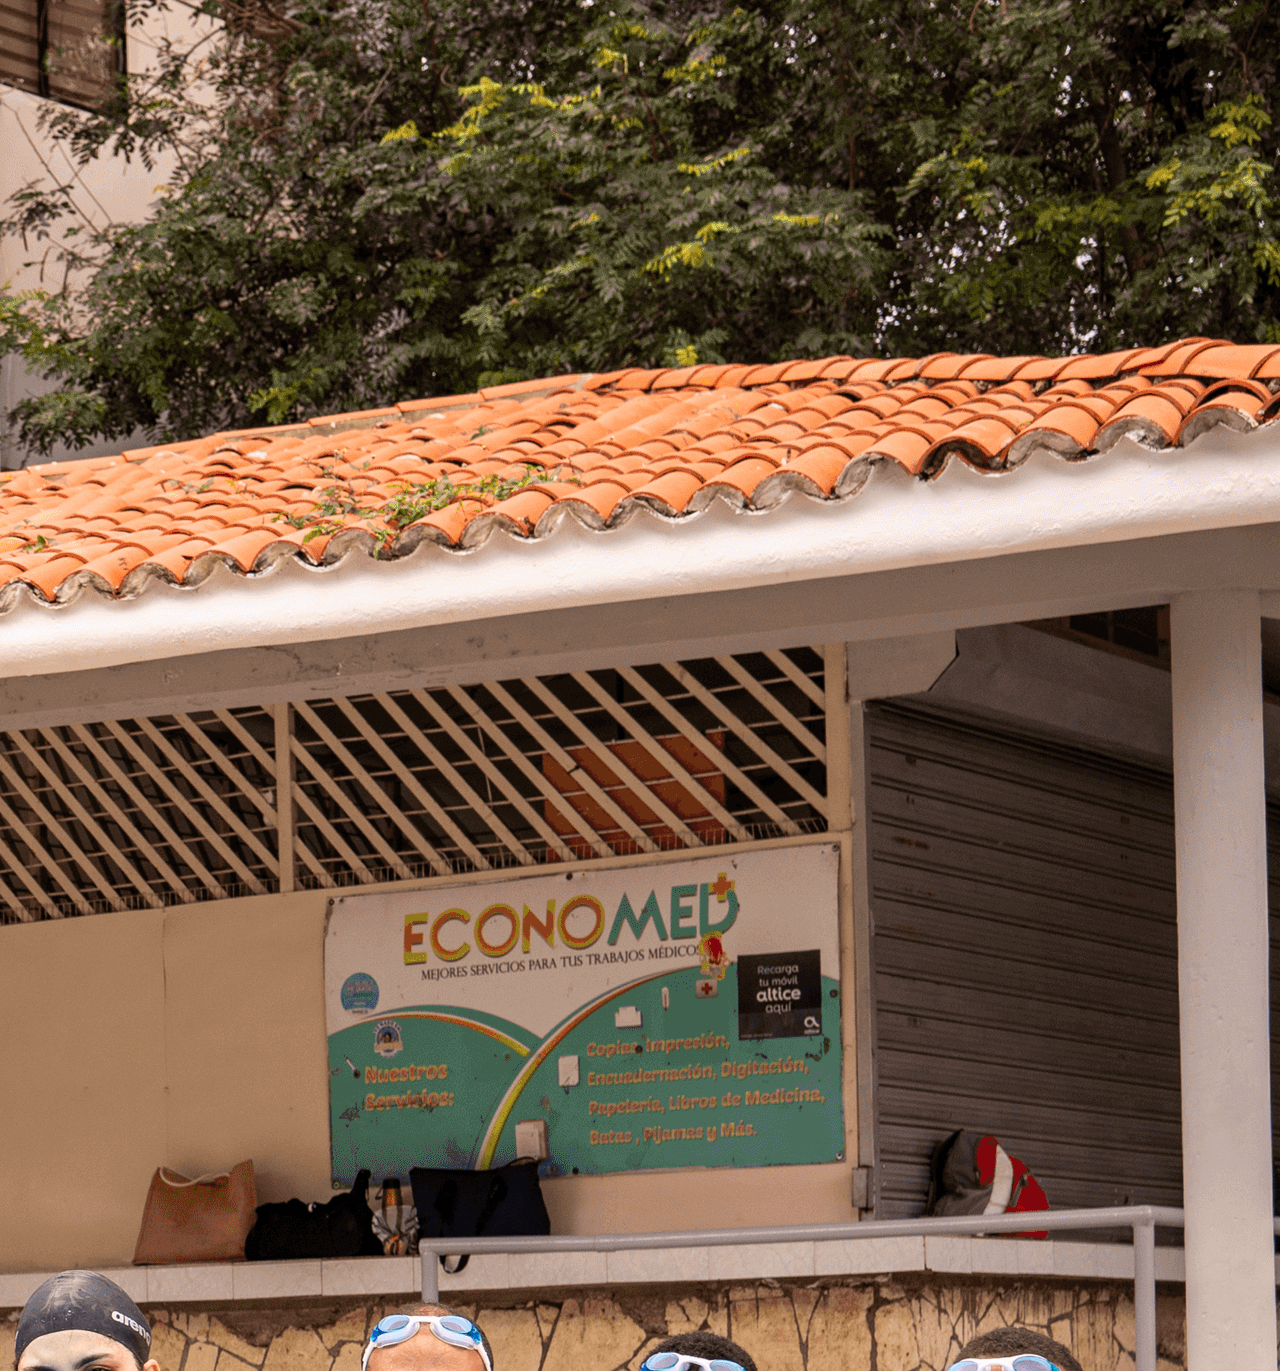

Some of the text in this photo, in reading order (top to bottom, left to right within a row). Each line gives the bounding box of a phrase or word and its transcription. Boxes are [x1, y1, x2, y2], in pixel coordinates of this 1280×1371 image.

[403, 878, 740, 965] ECONOMED
[421, 944, 700, 981] MEJORES SERVICIOS PARA TUS TRABAJOS MÉDICO
[757, 964, 799, 975] Recarga
[759, 975, 799, 987] tu móvil
[756, 986, 802, 1003] altice
[765, 1001, 792, 1015] aquí
[645, 1032, 731, 1055] Impresión,
[364, 1064, 448, 1085] Nuestros
[587, 1056, 810, 1087] Encuadernación, Digitación,
[364, 1088, 455, 1112] Servicios:
[589, 1086, 826, 1118] Papelería, Libros de Medicina,
[643, 1126, 704, 1145] Pijamas
[706, 1126, 718, 1143] y
[720, 1119, 758, 1137] Más.
